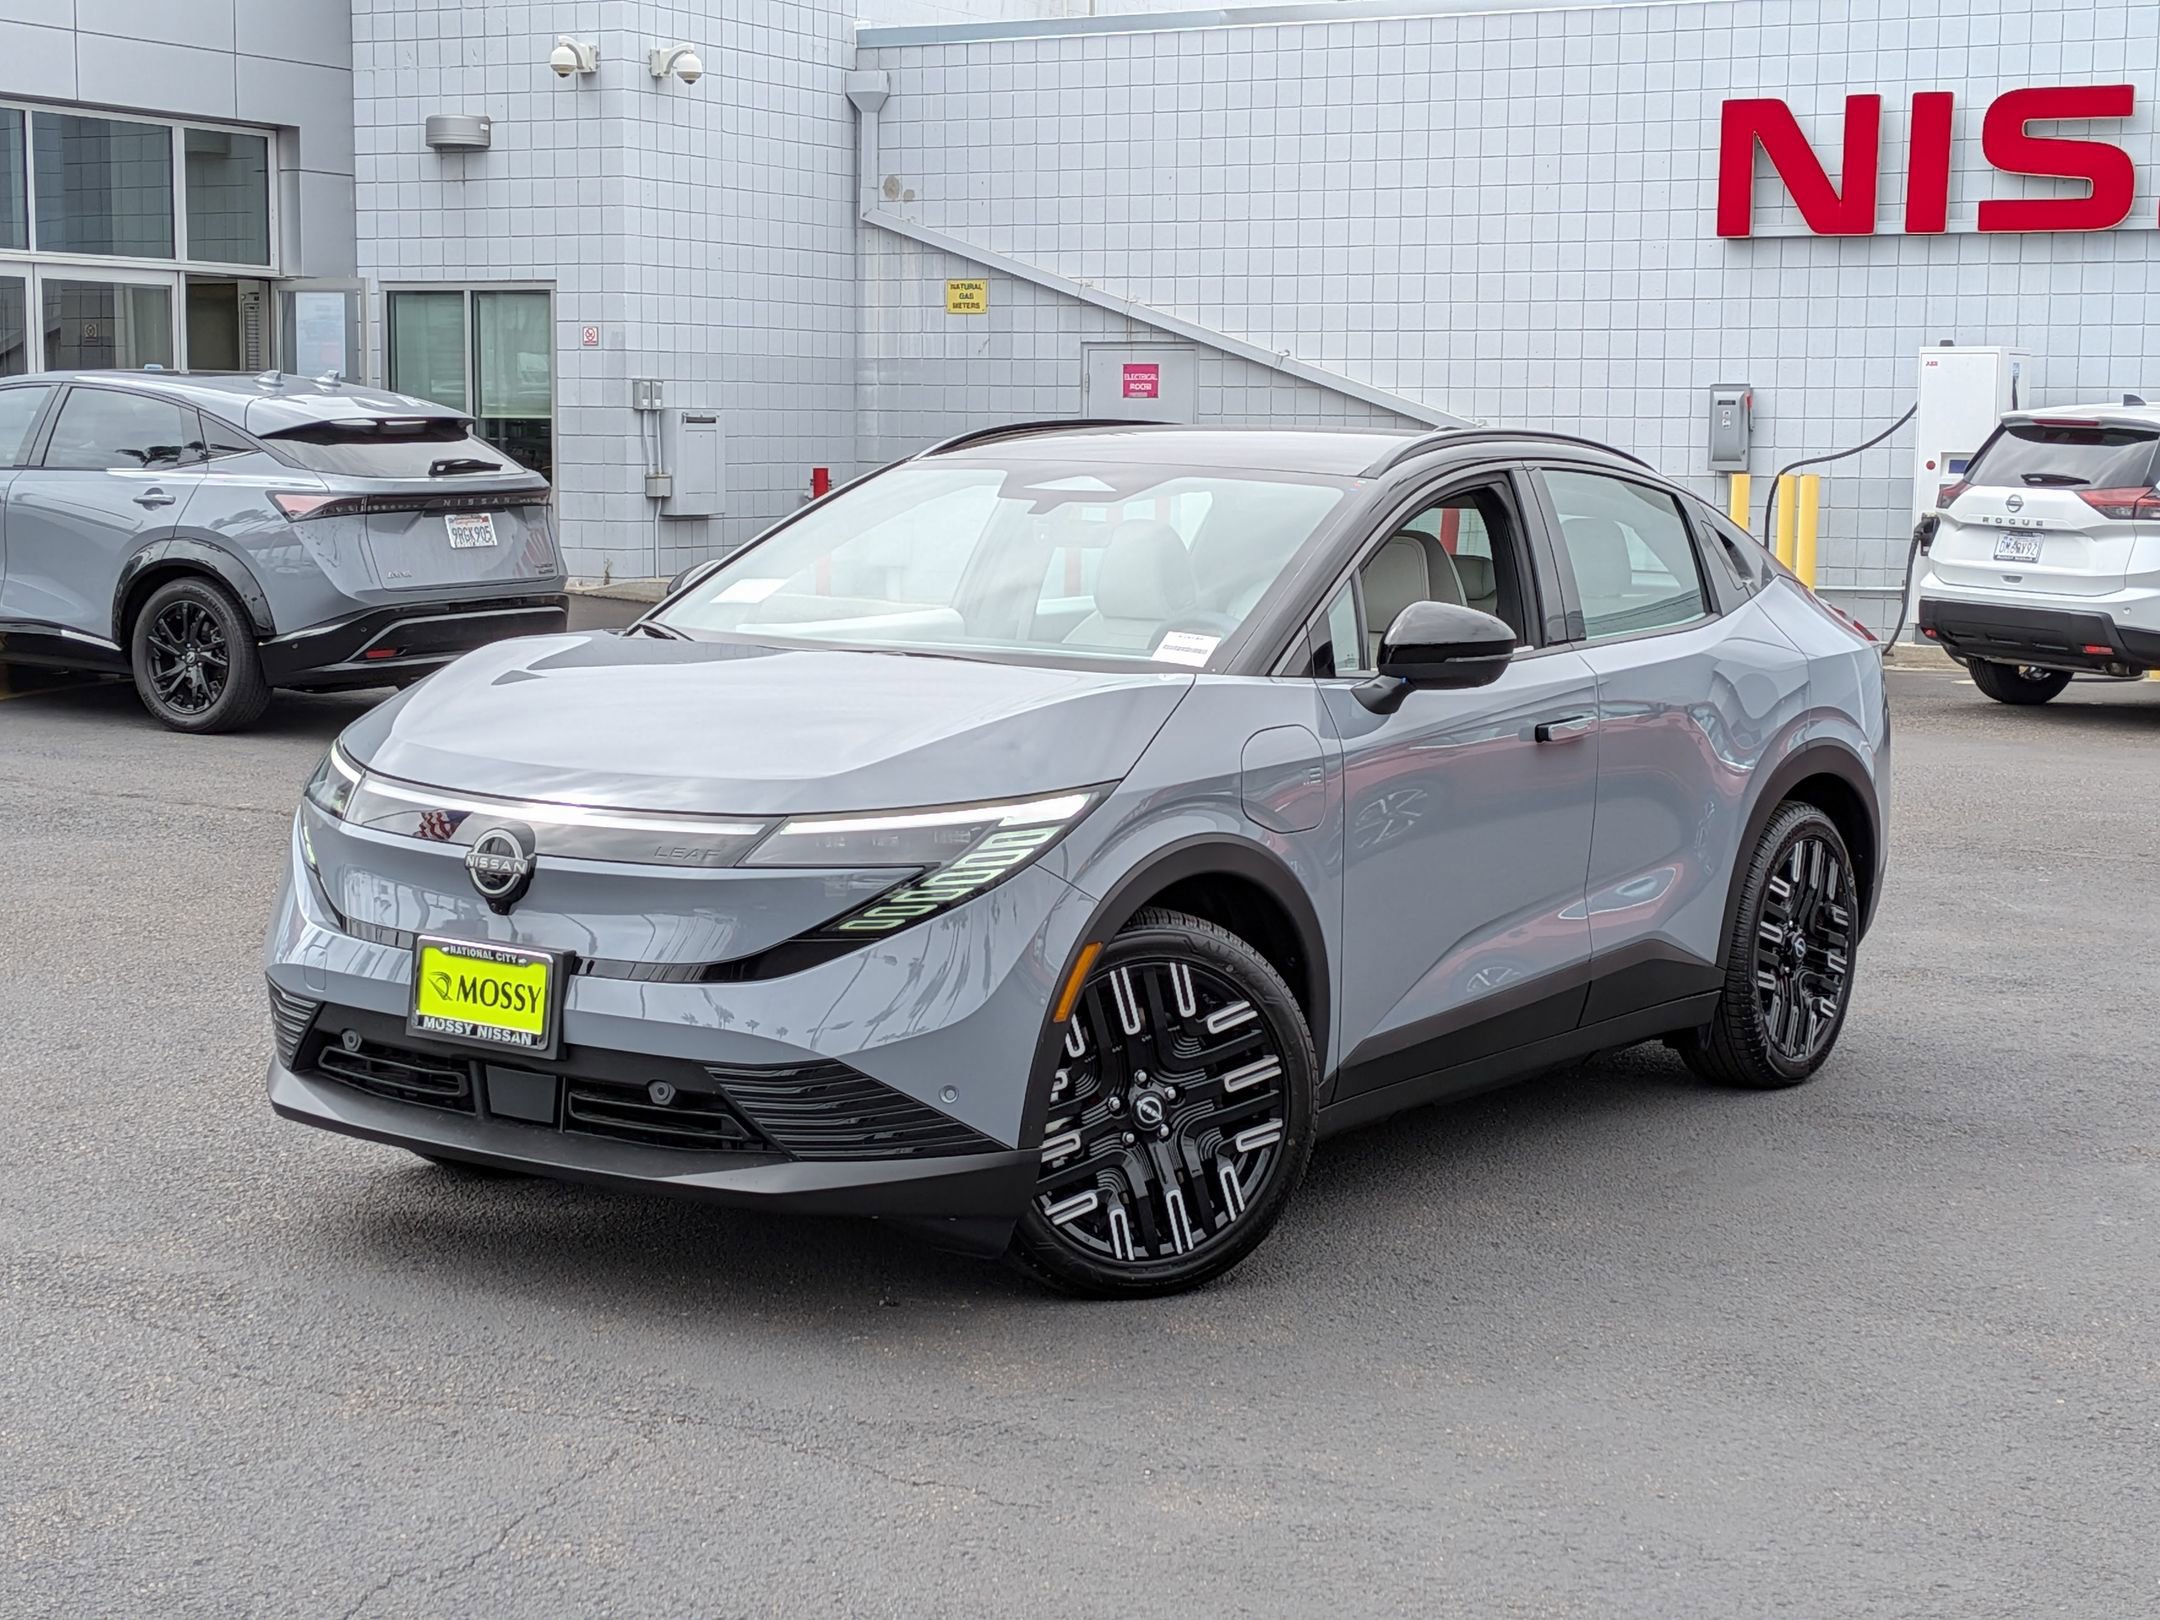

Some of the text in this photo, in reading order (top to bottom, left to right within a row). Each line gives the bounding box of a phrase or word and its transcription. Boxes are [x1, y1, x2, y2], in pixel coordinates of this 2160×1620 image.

[1717, 84, 2160, 237] NIS
[950, 283, 982, 291] NATURAL
[959, 292, 974, 300] GAS
[443, 497, 511, 506] NISSAN
[1982, 516, 2043, 527] ROGUE
[653, 845, 721, 861] LEAF
[465, 854, 527, 874] NISSAN
[450, 945, 518, 964] NATIONAL CITY
[456, 975, 542, 1014] MOSSY
[423, 1016, 532, 1046] MOSSY NISSAN
